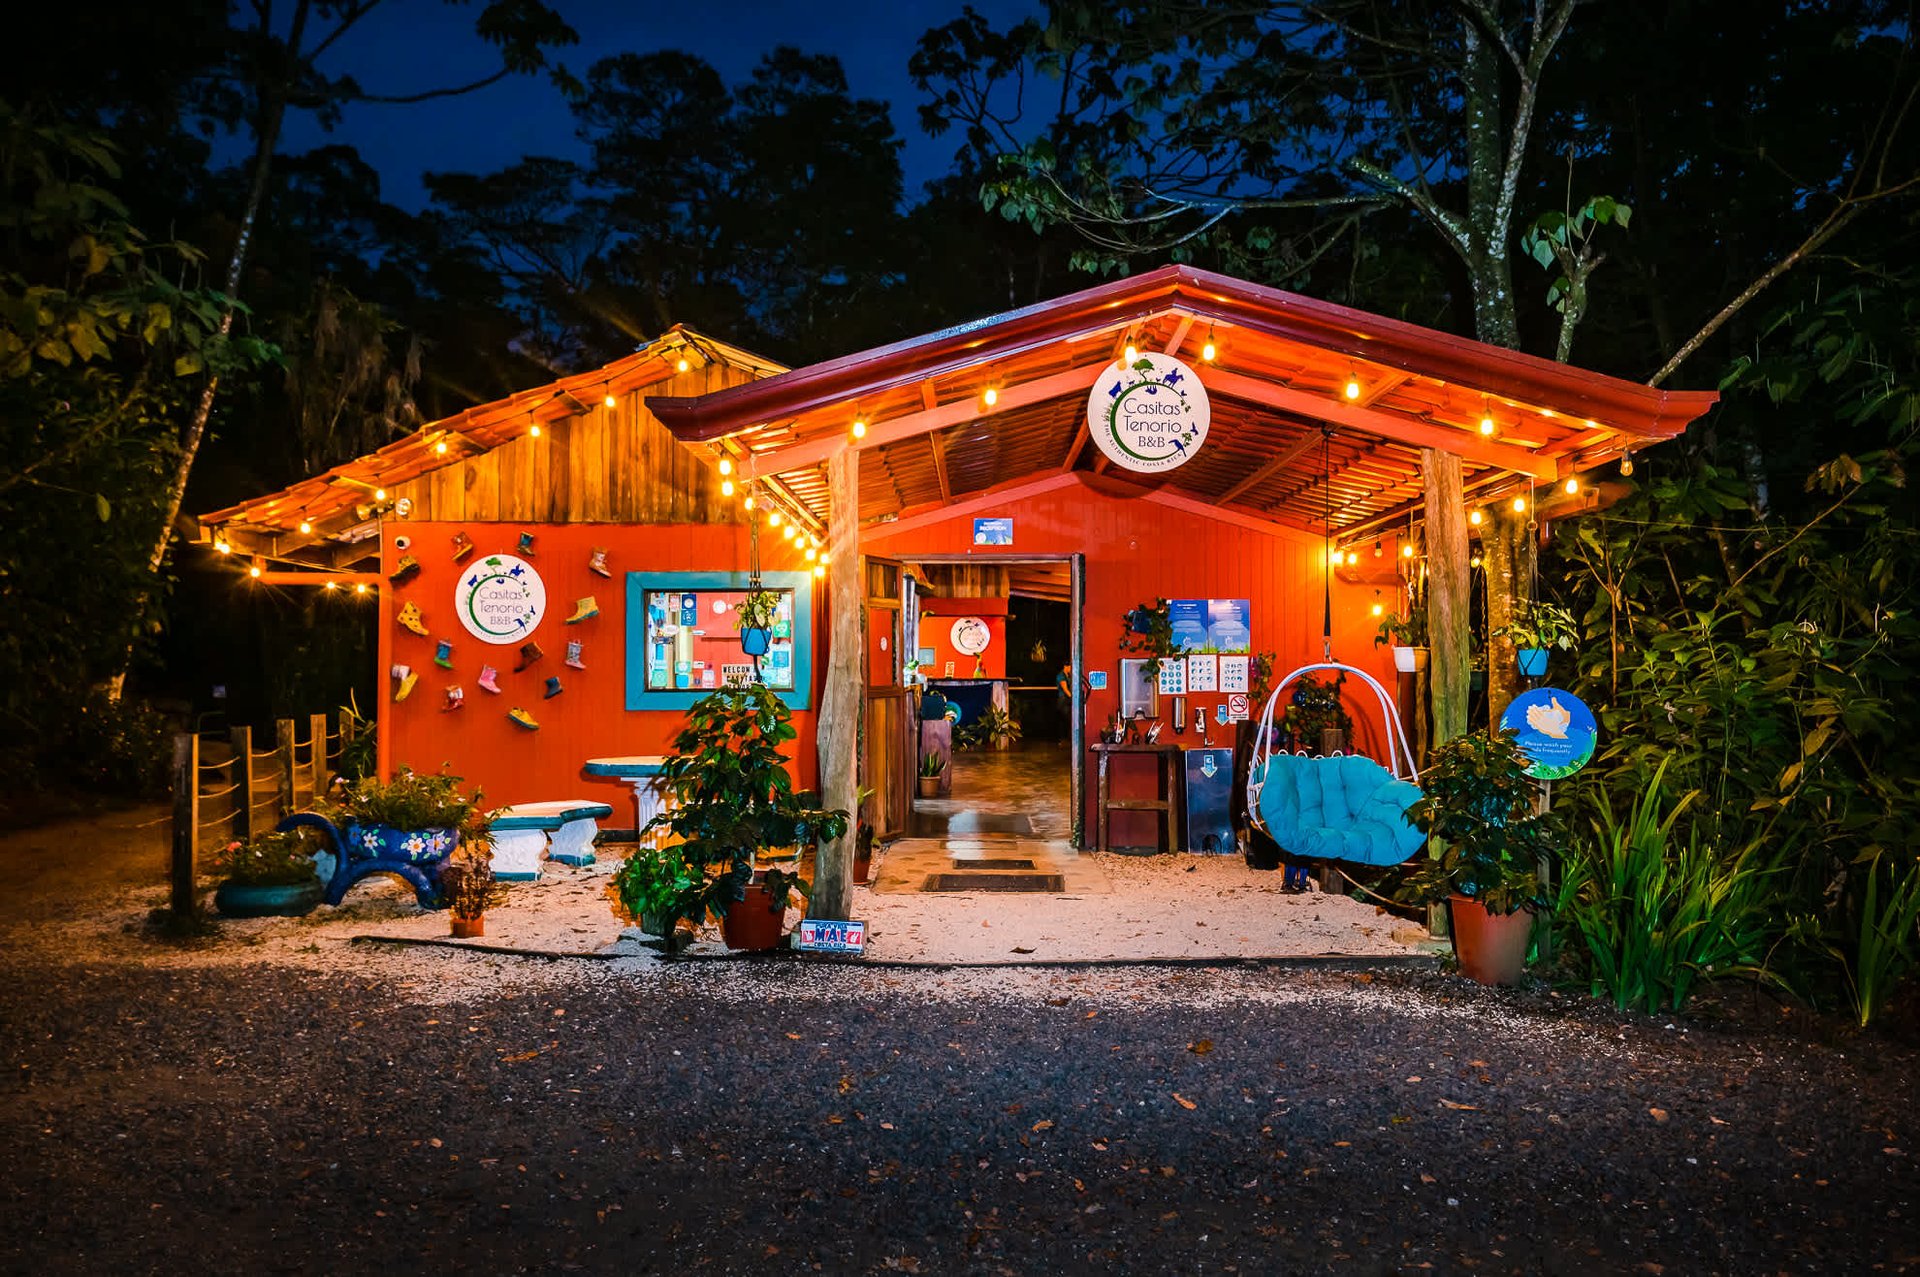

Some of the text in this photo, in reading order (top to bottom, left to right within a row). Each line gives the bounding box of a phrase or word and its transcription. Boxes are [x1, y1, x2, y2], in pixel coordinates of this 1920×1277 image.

[1123, 398, 1181, 415] Casitas
[1124, 415, 1182, 433] Tenorio
[1138, 435, 1166, 448] B&B
[479, 586, 523, 600] Casitas
[479, 600, 524, 613] Tenorio
[489, 616, 511, 625] B&B
